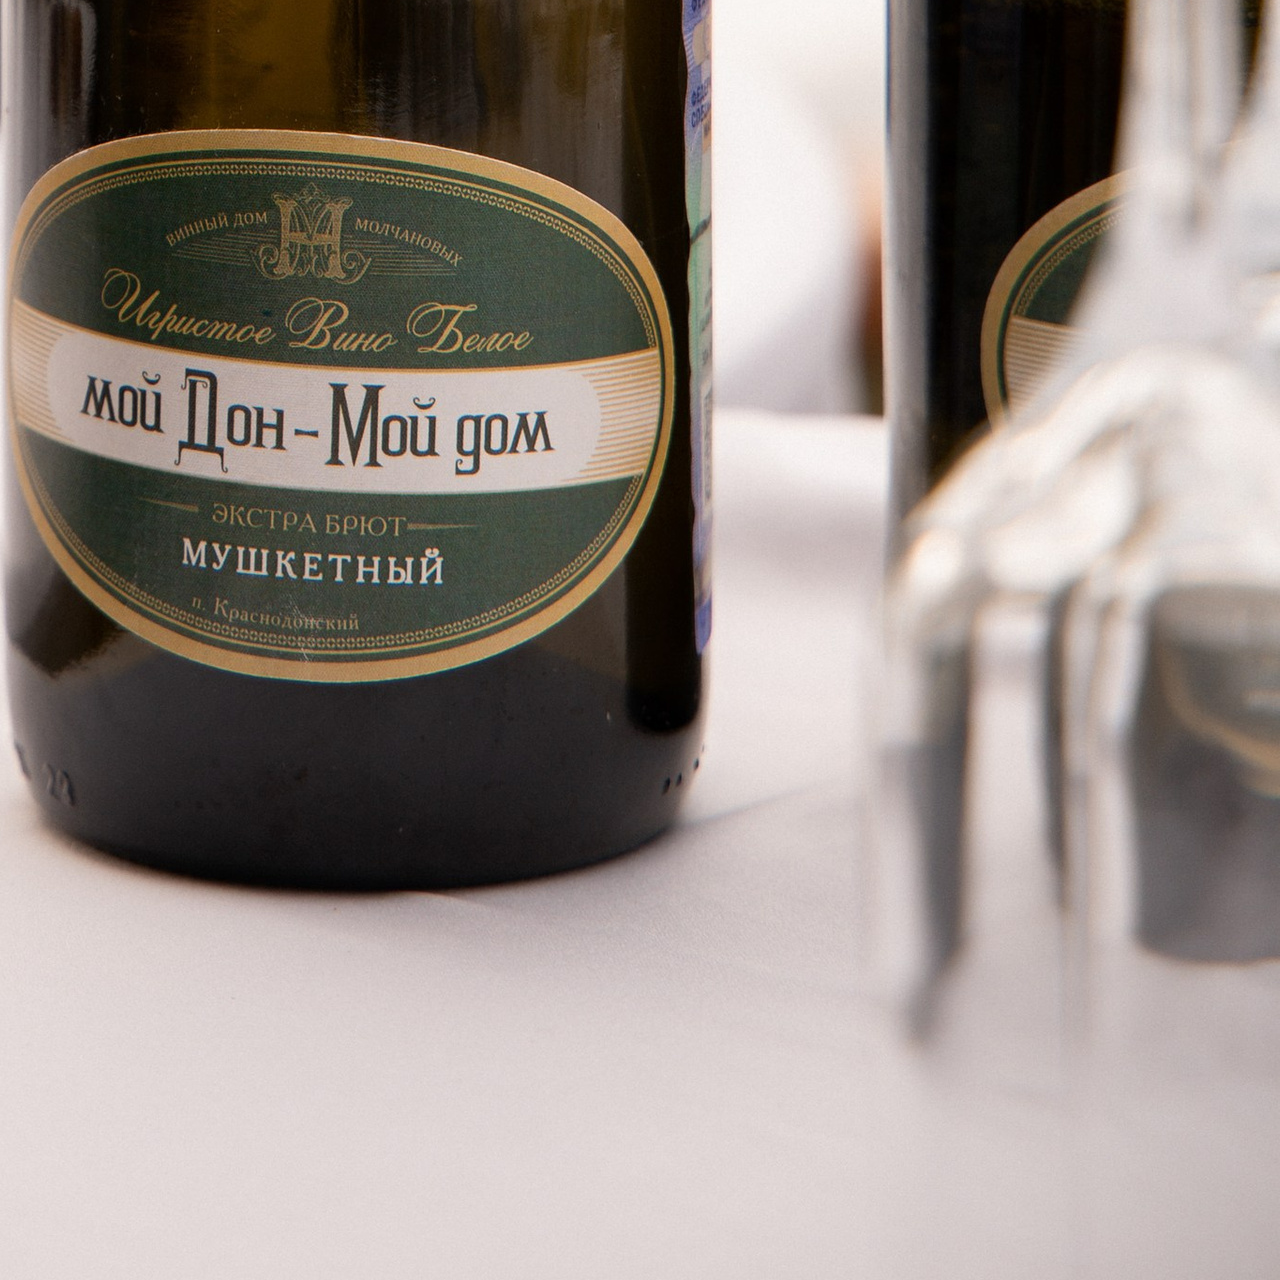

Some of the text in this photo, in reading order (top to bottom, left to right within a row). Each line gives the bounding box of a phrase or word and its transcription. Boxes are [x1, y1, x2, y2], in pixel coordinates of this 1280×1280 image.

[165, 211, 464, 268] ВИННЫЙ ДОМ МОЛЧАНОВЫХ
[101, 268, 535, 354] Игристое Вино Белое
[79, 370, 165, 434] мой
[454, 410, 556, 476] дом
[211, 503, 407, 537] ЭКСТРА БРЮТ
[181, 537, 444, 585] МУШКЕТНЫЙ
[191, 596, 360, 631] п. Краснодонский
